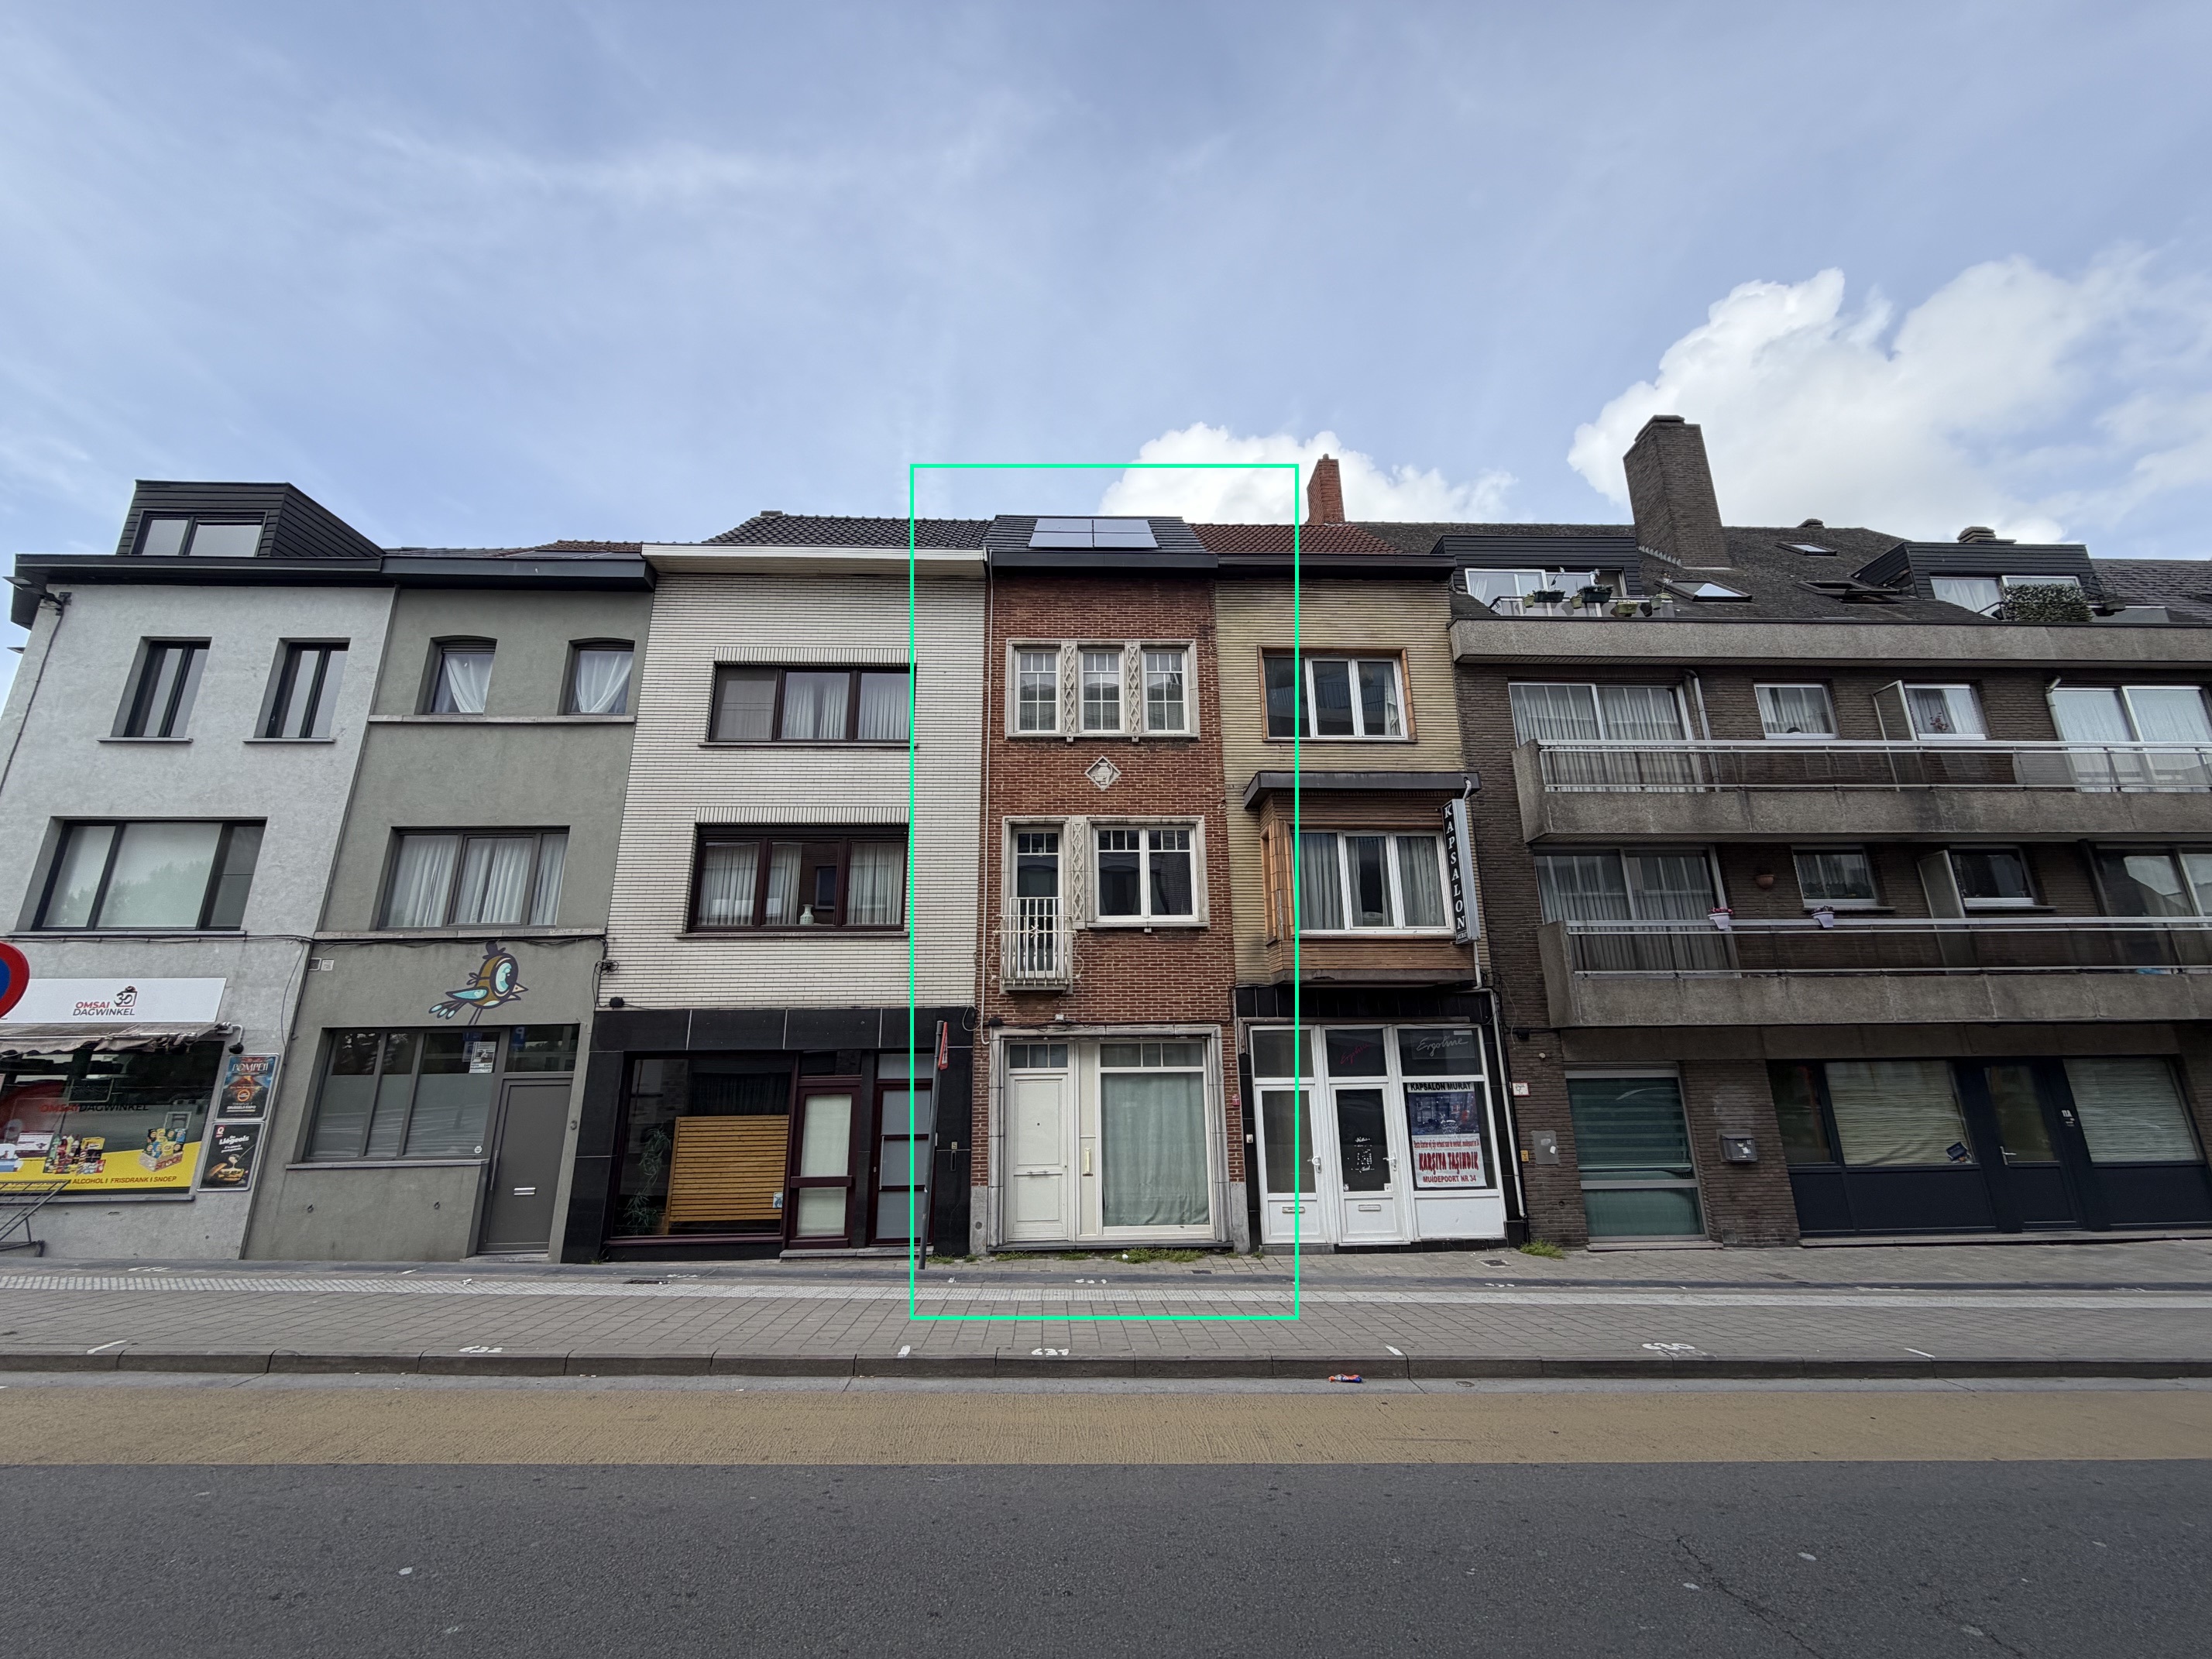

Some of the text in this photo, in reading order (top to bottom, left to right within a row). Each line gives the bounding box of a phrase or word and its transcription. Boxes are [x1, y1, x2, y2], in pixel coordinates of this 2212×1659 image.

[1444, 803, 1465, 929] KAPSALON
[1417, 1036, 1468, 1056] Ergoline
[232, 1063, 269, 1072] POMPEII
[1410, 1082, 1471, 1091] KAPSALON MURAT
[570, 1120, 578, 1130] 3
